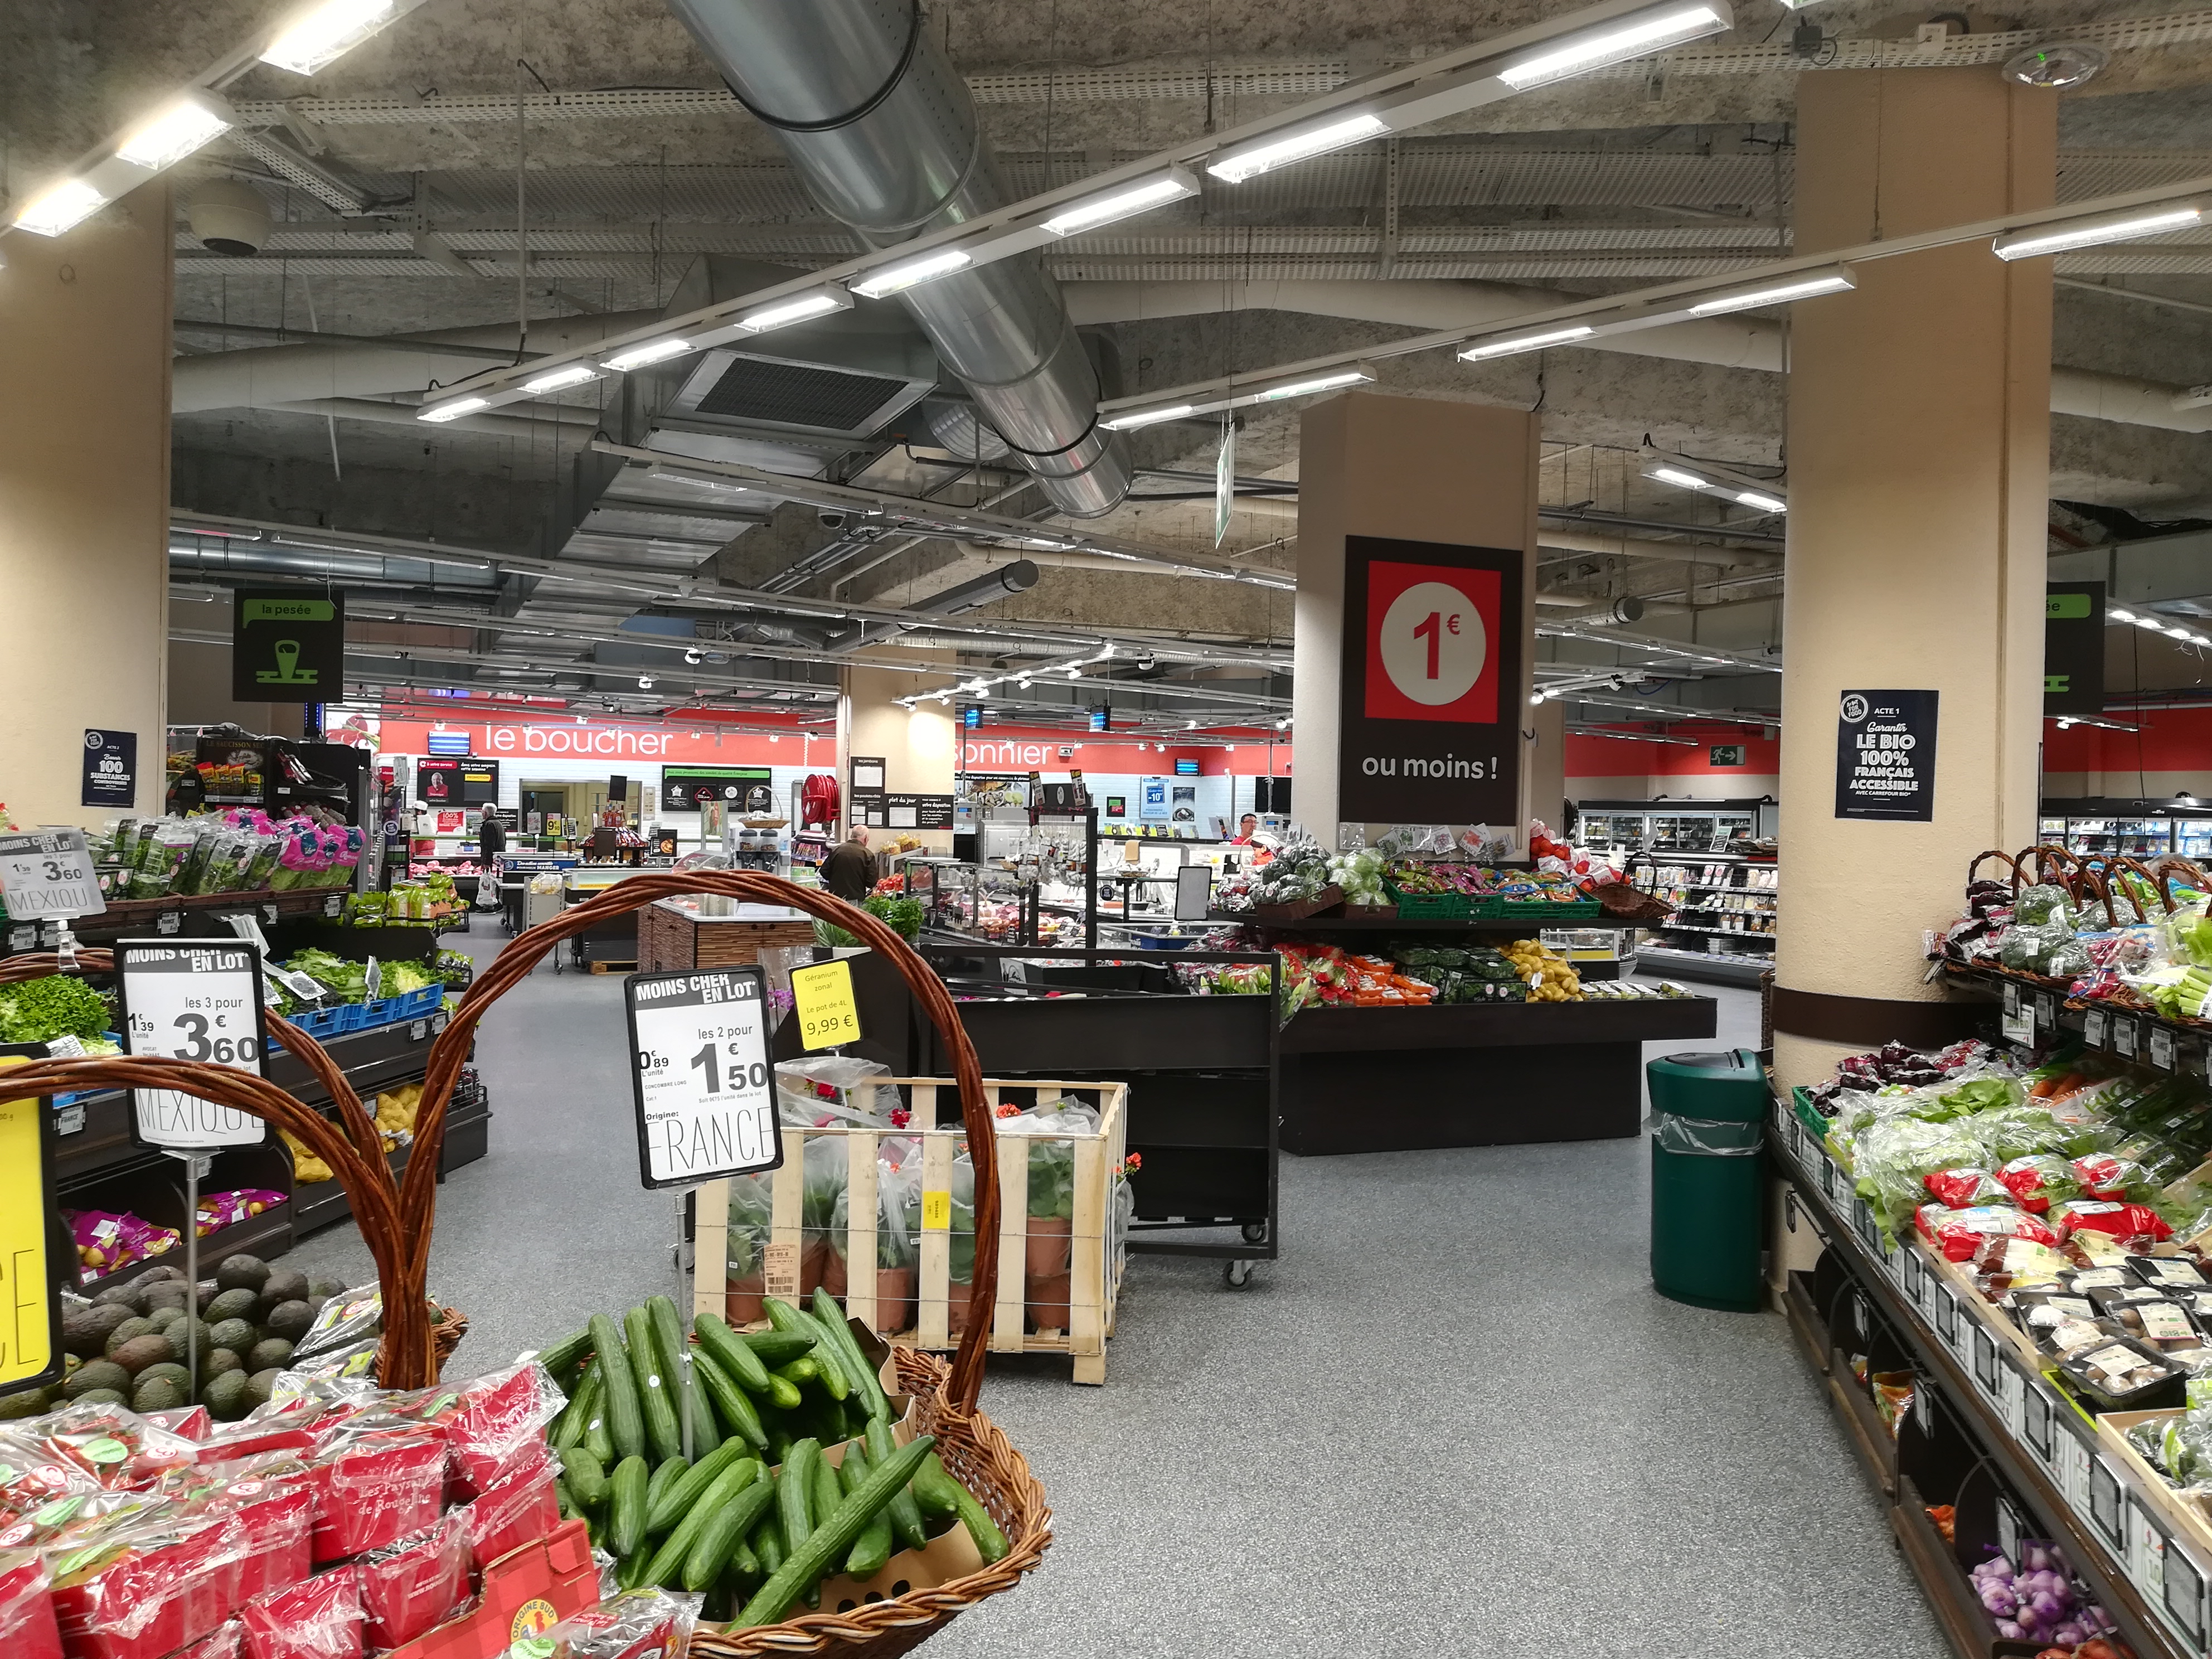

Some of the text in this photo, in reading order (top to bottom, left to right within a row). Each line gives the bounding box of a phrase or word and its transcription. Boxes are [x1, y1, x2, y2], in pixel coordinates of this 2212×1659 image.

[263, 604, 311, 617] la pesée
[1848, 709, 1862, 717] FOOD
[1867, 721, 1908, 733] Garantir
[486, 721, 673, 755] le boucher
[1856, 734, 1916, 750] LE BIO
[955, 744, 1052, 765] onnier
[1860, 750, 1909, 766] 100%
[99, 760, 123, 774] 100
[1362, 756, 1395, 777] ou
[1403, 753, 1485, 779] moins
[90, 772, 130, 780] SUBSTANCES
[1855, 767, 1914, 780] FRANÇAIS
[1849, 779, 1919, 791] ACCESSIBLE
[0, 834, 58, 851] MOINS CHER
[41, 843, 56, 853] EN
[126, 949, 176, 963] MOINS
[191, 955, 212, 972] EN
[805, 971, 838, 982] Géranium
[636, 974, 730, 1001] MOINS CHER
[814, 982, 832, 991] zonal
[702, 987, 723, 1004] EN
[186, 997, 243, 1010] les 3 pour
[816, 1004, 827, 1012] pot
[698, 1025, 753, 1039] les 2 pour
[807, 1017, 839, 1036] 9,99
[138, 1088, 265, 1134] MEXIQU
[646, 1111, 679, 1121] Origine:
[360, 1486, 380, 1499] Les
[358, 1502, 372, 1515] de
[512, 1600, 539, 1639] ORIGINE
